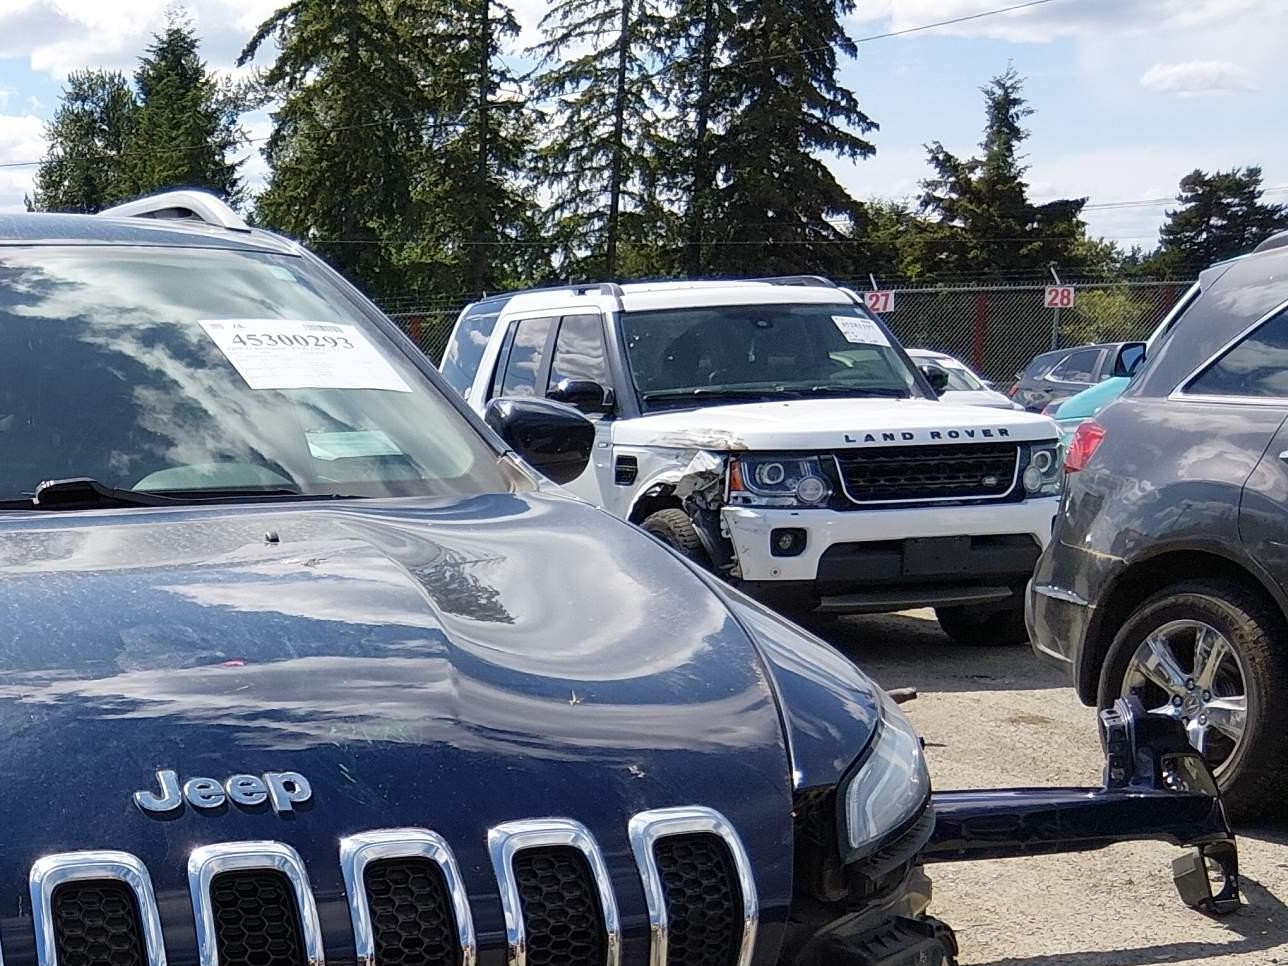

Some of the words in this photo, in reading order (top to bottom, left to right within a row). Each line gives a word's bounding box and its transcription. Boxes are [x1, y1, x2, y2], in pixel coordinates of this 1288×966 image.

[868, 293, 890, 312] 27
[1048, 288, 1071, 307] 28
[232, 333, 355, 350] 45300293
[844, 431, 914, 443] LAND
[931, 427, 1010, 440] ROVER
[133, 769, 313, 816] Jeep
